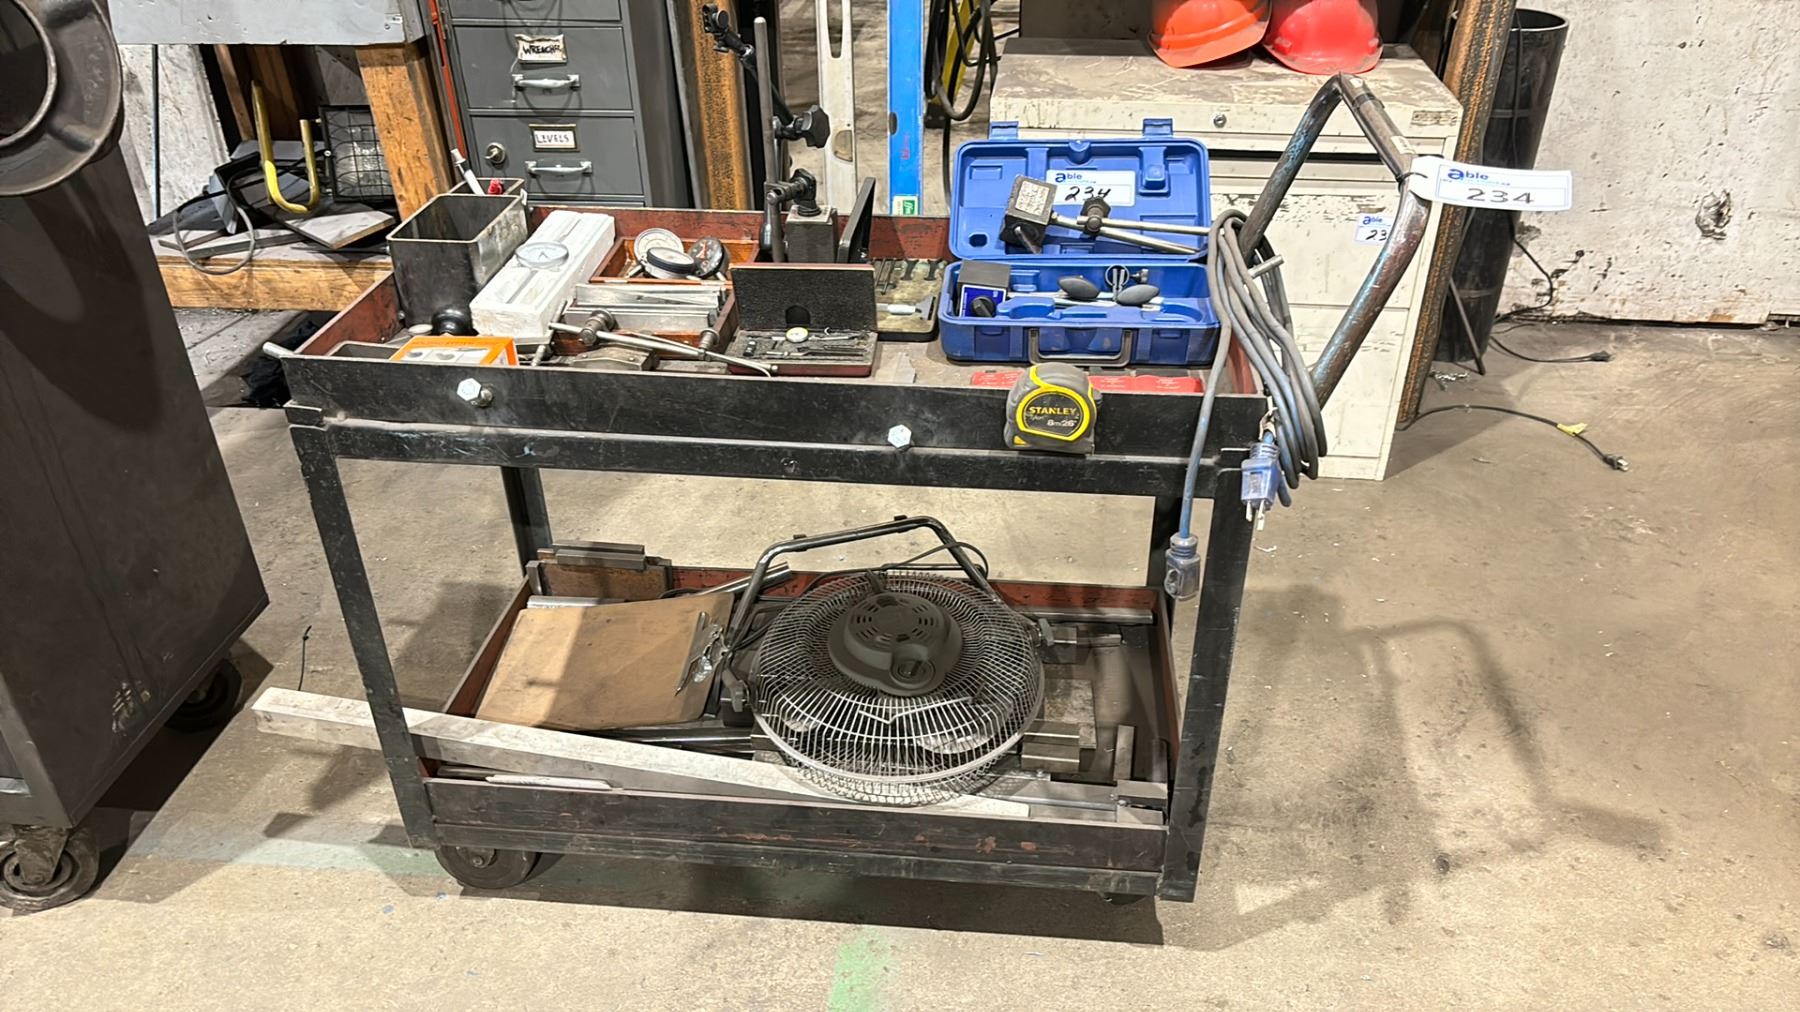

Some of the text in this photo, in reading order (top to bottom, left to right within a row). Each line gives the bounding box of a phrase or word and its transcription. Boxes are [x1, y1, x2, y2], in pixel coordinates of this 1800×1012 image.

[535, 134, 570, 144] LEVELS
[1055, 172, 1083, 183] able
[1447, 168, 1489, 181] able
[1064, 185, 1112, 202] 234
[1467, 187, 1535, 204] 234
[1028, 406, 1077, 416] STANLEY
